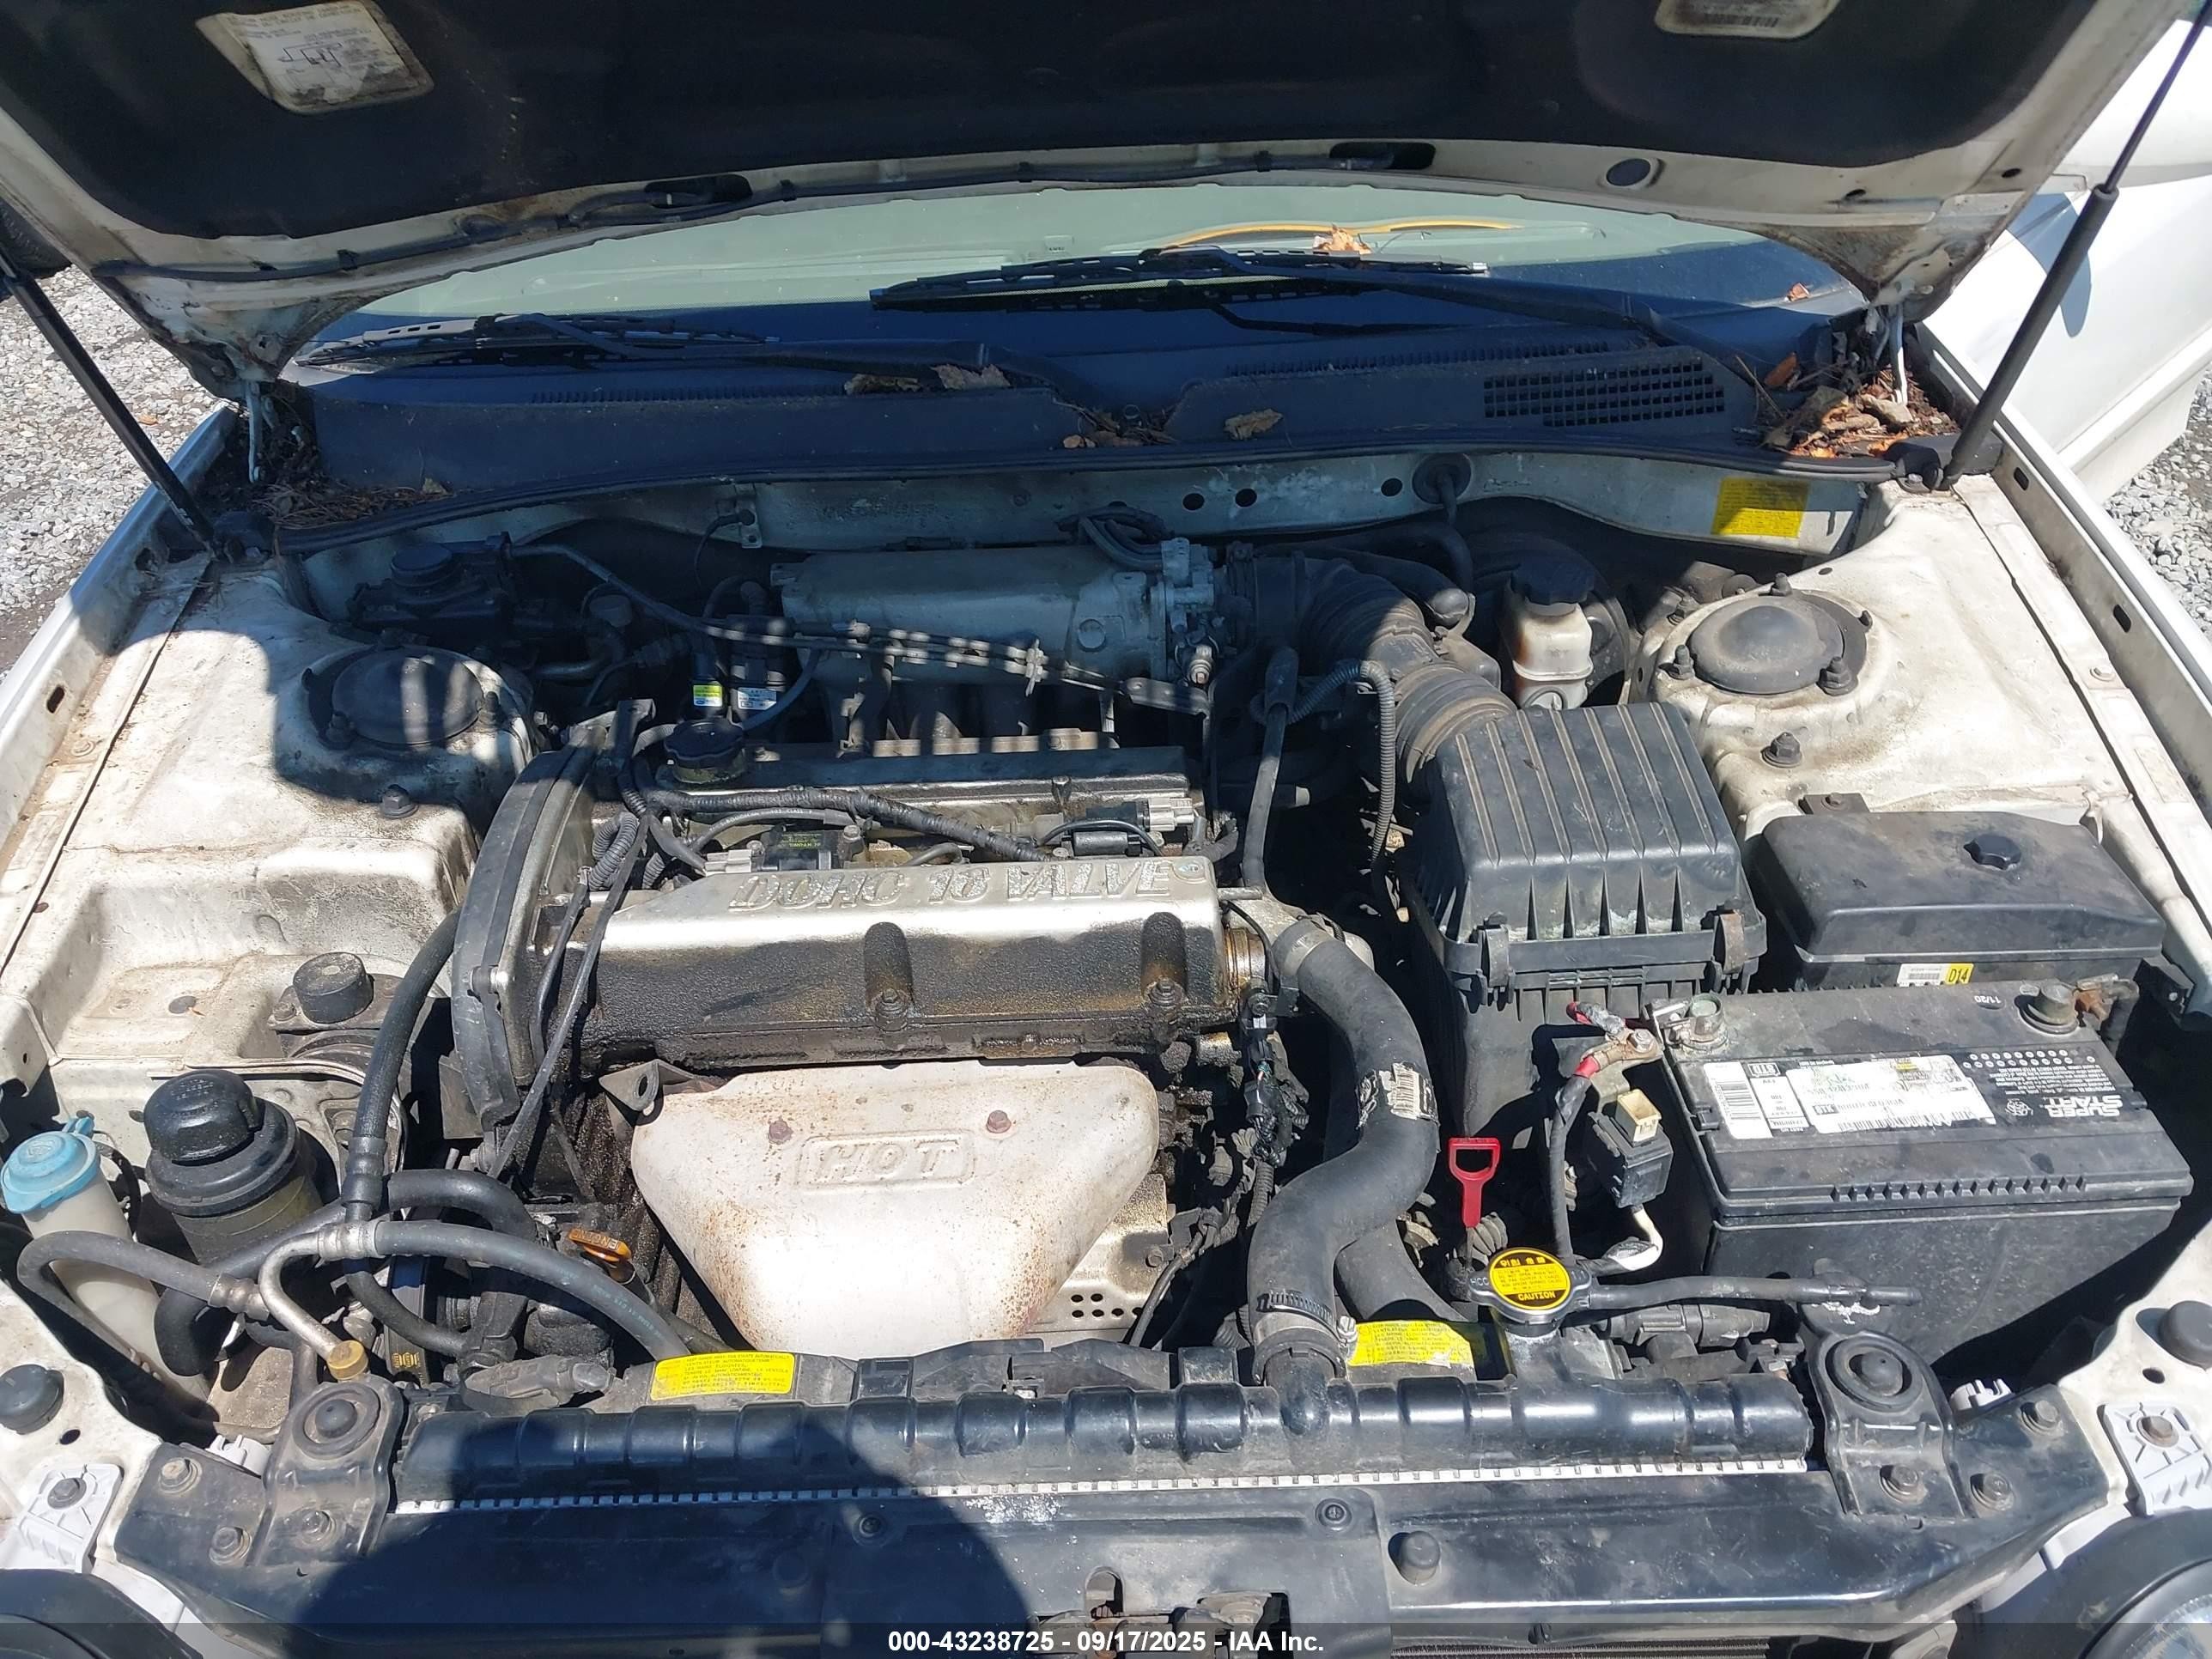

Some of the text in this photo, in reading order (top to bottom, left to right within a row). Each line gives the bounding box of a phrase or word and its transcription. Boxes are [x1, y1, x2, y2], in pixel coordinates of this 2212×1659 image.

[728, 860, 1173, 914] DOHC 16 VALVE
[1973, 995, 2002, 1004] 11/20
[2045, 1094, 2124, 1108] START
[2047, 1104, 2120, 1117] SUPER
[817, 1139, 959, 1182] HOT
[569, 1228, 620, 1251] ENGINE
[1517, 1291, 1556, 1302] CAUTION
